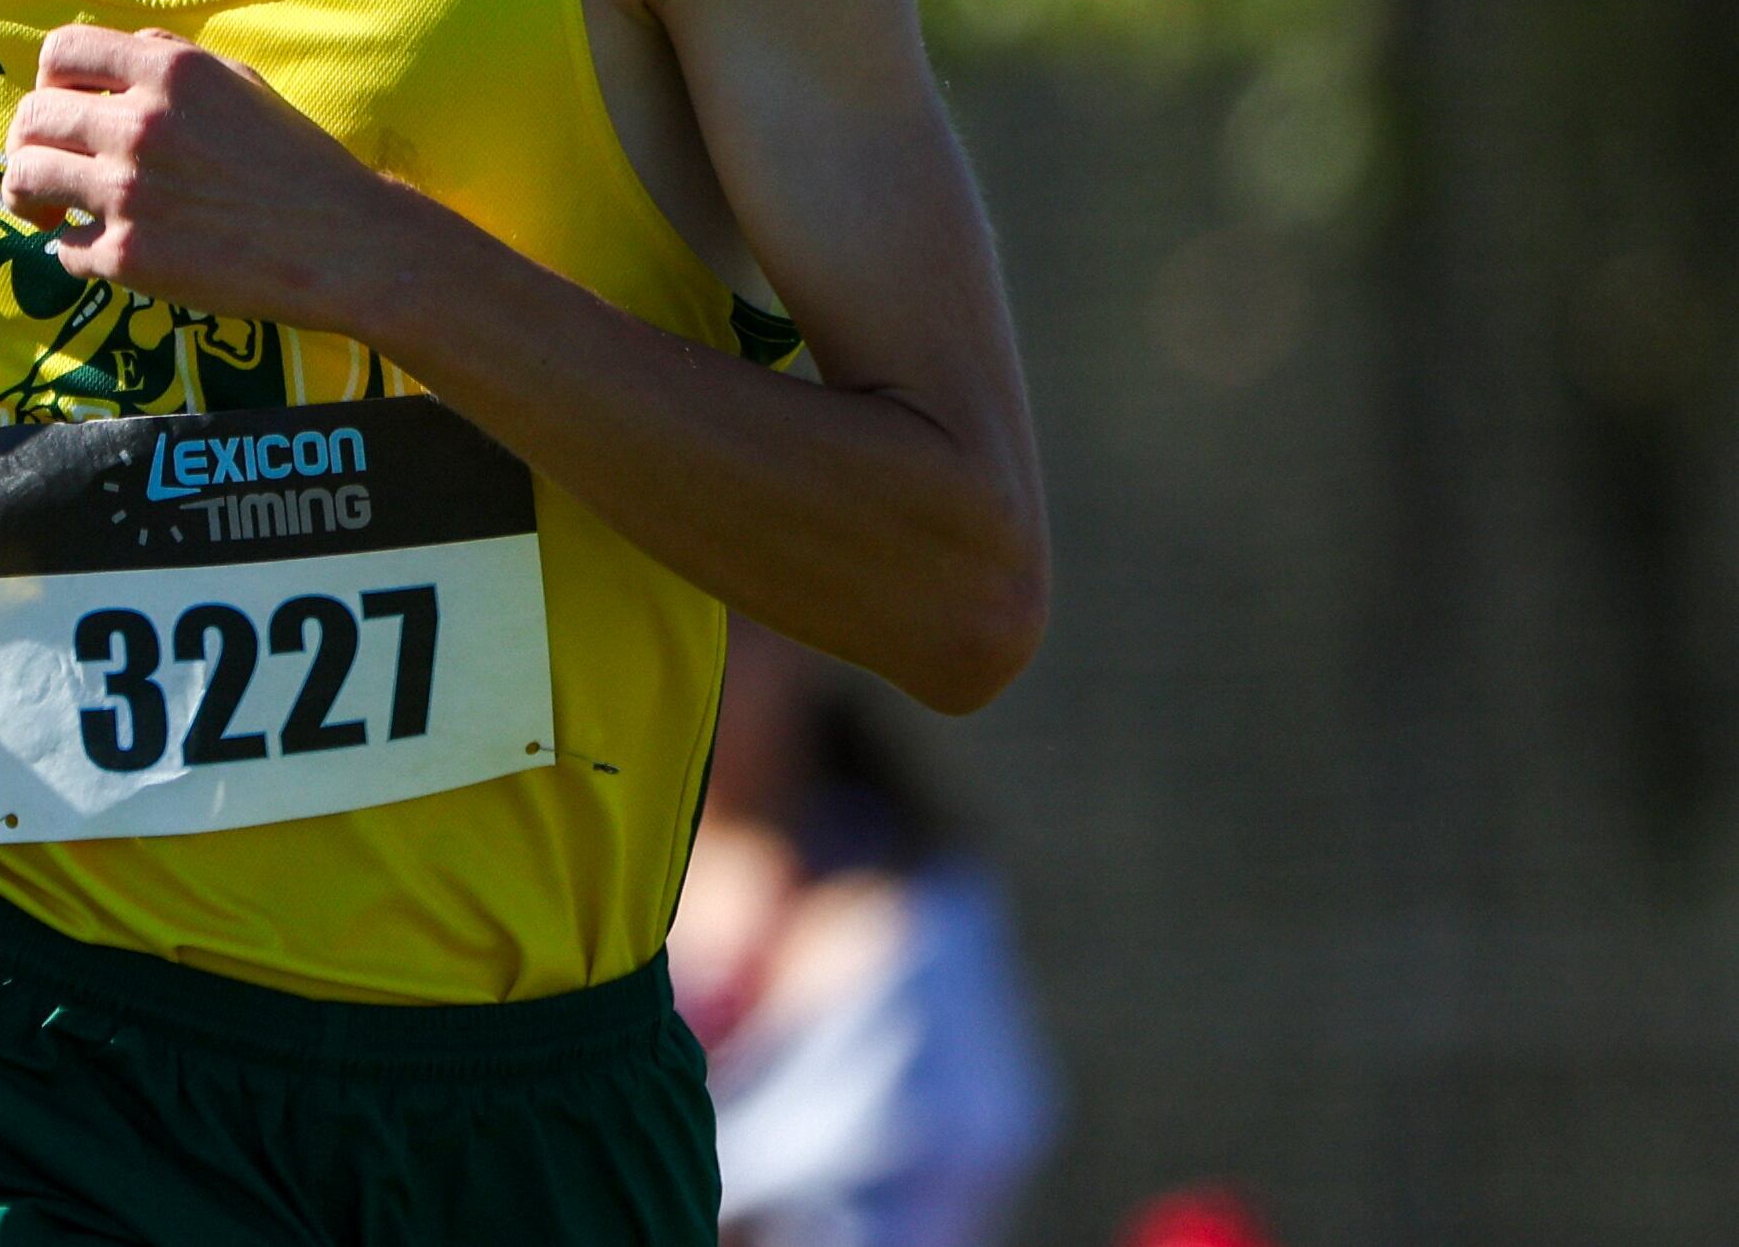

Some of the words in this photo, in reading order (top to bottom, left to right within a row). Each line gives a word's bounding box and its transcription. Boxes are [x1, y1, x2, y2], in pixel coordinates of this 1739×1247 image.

[114, 349, 146, 393] E
[146, 427, 367, 500] LEXICON
[181, 485, 372, 542] TIMING
[74, 583, 439, 774] 3227
